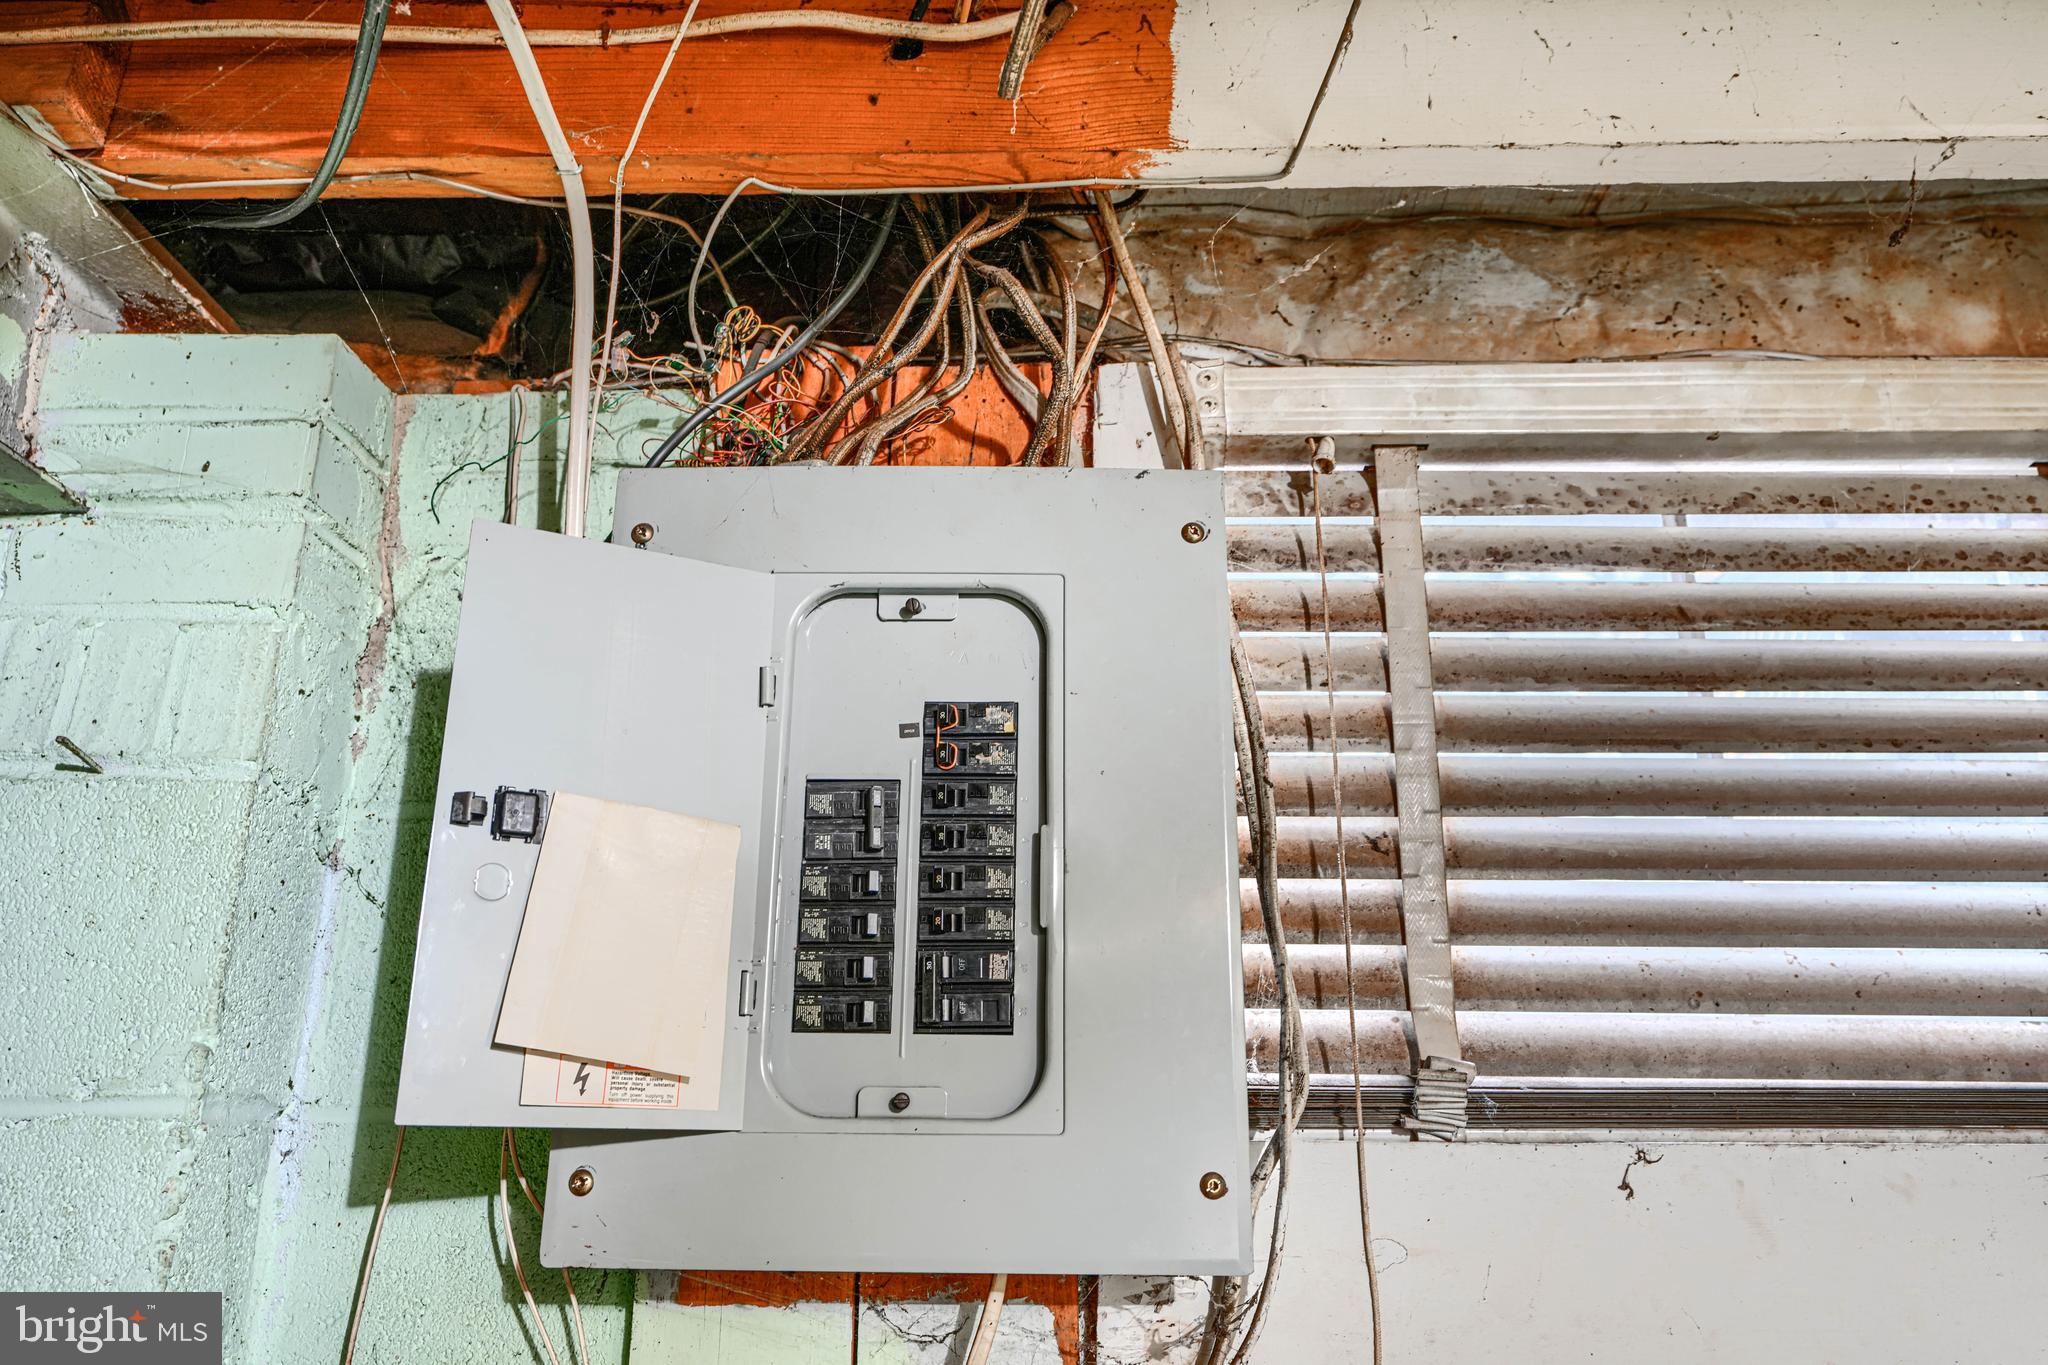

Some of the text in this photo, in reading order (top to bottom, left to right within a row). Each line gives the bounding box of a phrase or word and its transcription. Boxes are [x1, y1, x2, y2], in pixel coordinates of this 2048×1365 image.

[939, 711, 946, 719] 30
[939, 750, 946, 758] 30
[937, 791, 944, 800] 20
[938, 832, 944, 841] 20
[935, 874, 942, 883] 20
[934, 916, 941, 926] 20
[926, 961, 933, 970] 30
[958, 958, 966, 971] OFF
